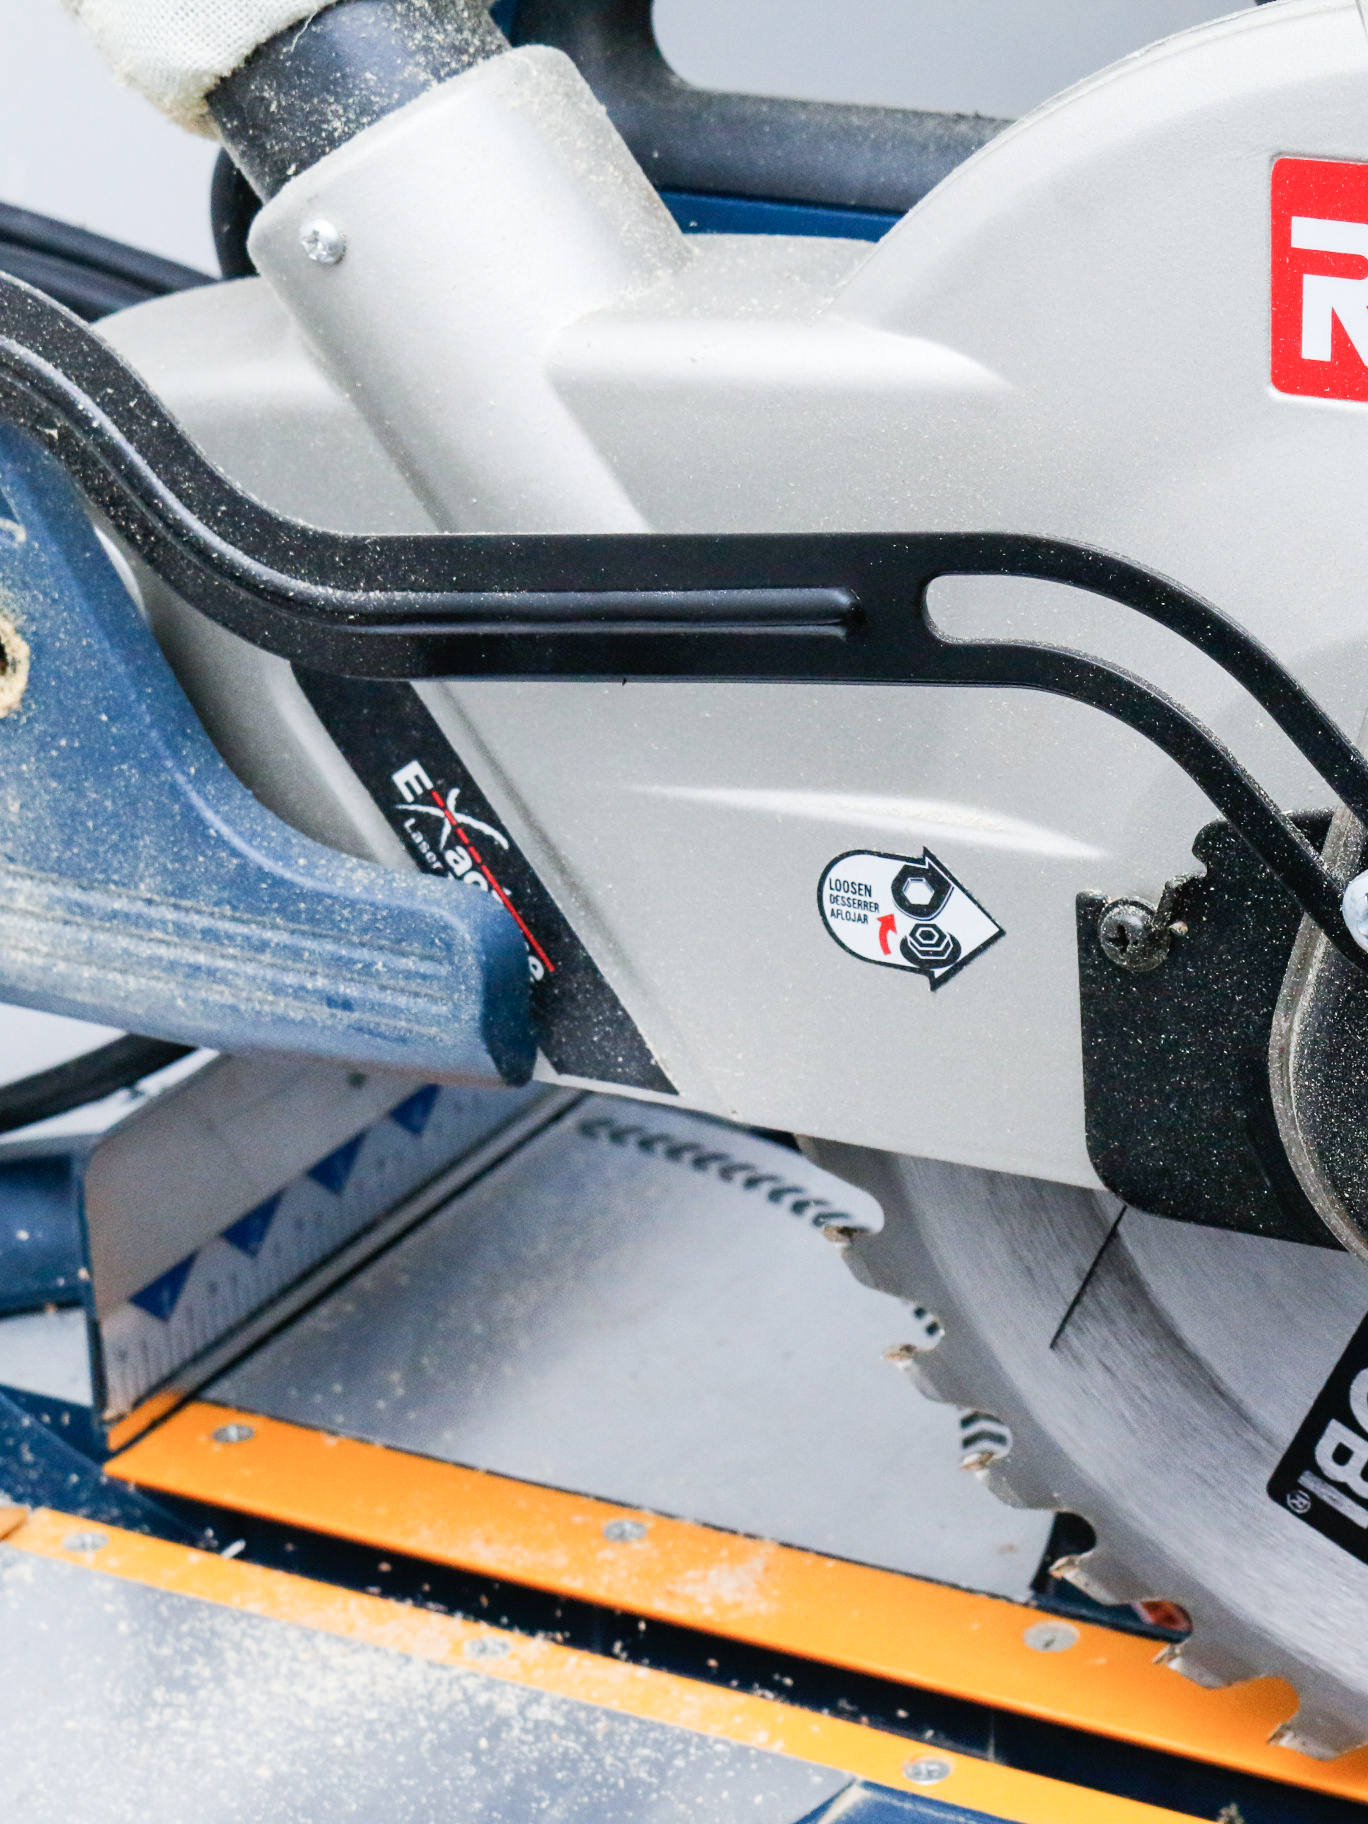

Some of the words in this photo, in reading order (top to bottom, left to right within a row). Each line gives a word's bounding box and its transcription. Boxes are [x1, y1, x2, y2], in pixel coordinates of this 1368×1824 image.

[404, 818, 443, 870] Laser
[829, 877, 872, 898] LOOSEN
[829, 894, 880, 914] DESSERRER
[830, 908, 869, 925] AFLOJAR
